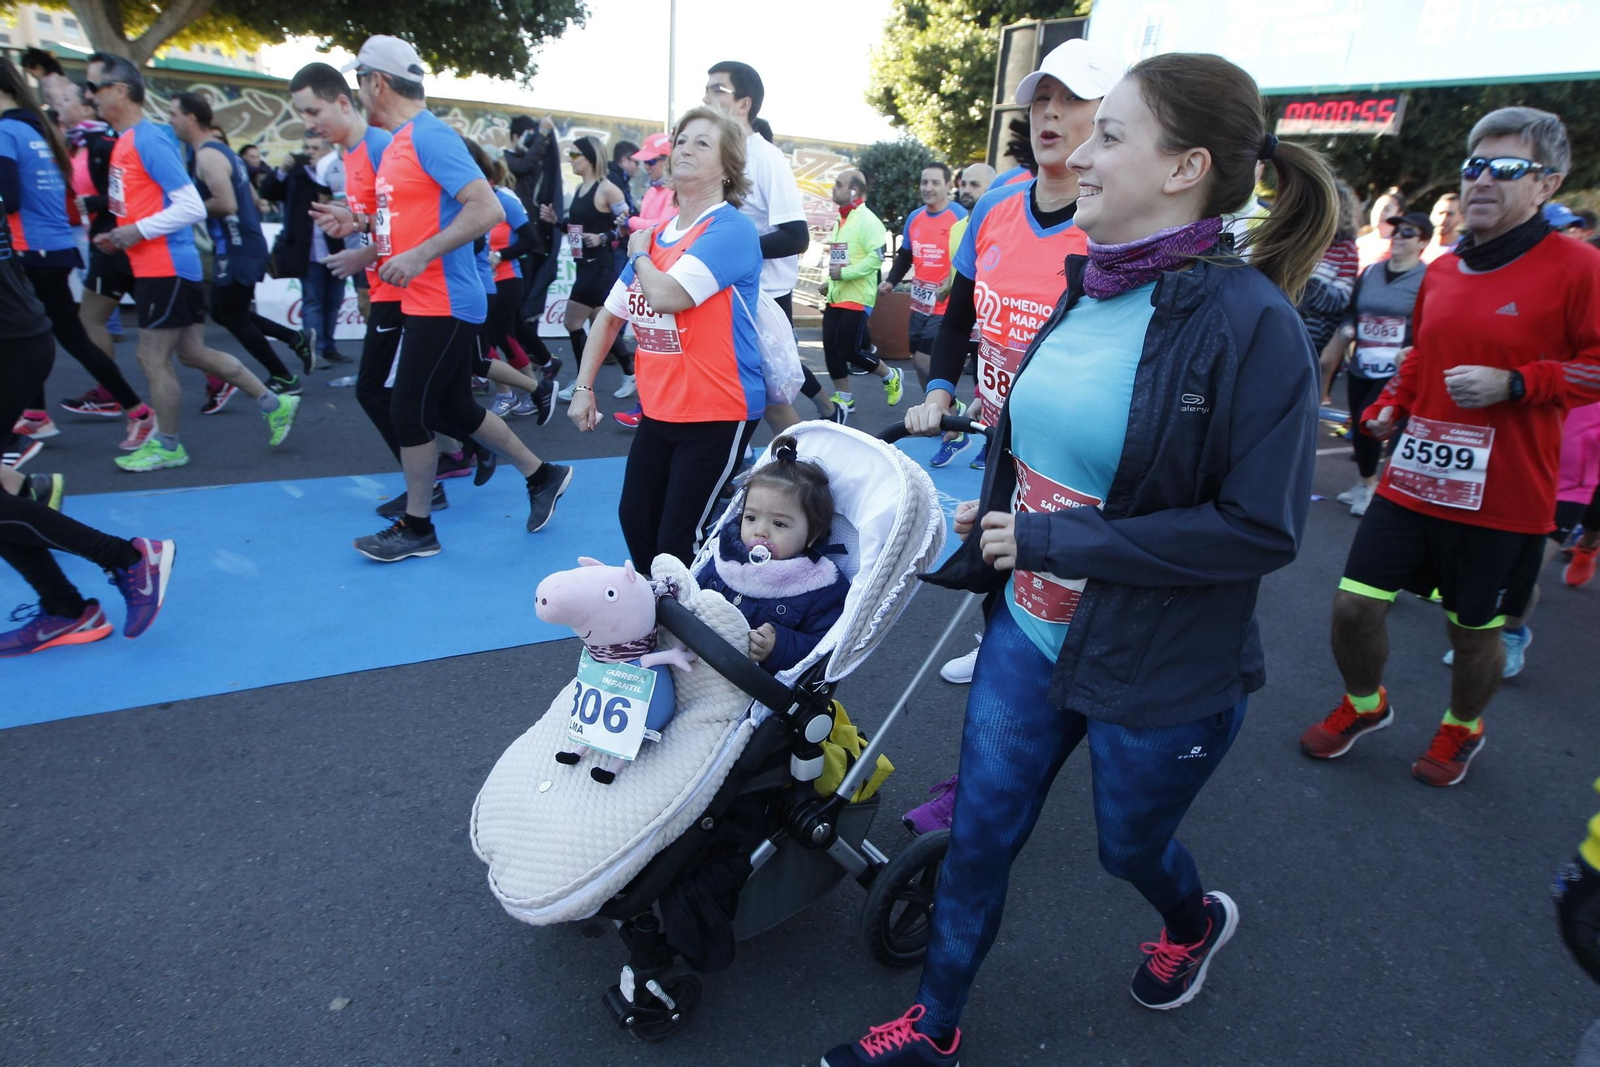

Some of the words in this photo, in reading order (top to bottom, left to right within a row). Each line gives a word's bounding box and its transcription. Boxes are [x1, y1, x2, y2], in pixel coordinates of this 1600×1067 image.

[628, 293, 663, 319] 585
[1010, 298, 1053, 318] MEDIO
[1401, 437, 1475, 470] 5599
[1040, 499, 1063, 513] SAL
[602, 676, 643, 694] INFANTIL
[606, 668, 646, 684] CARRERA
